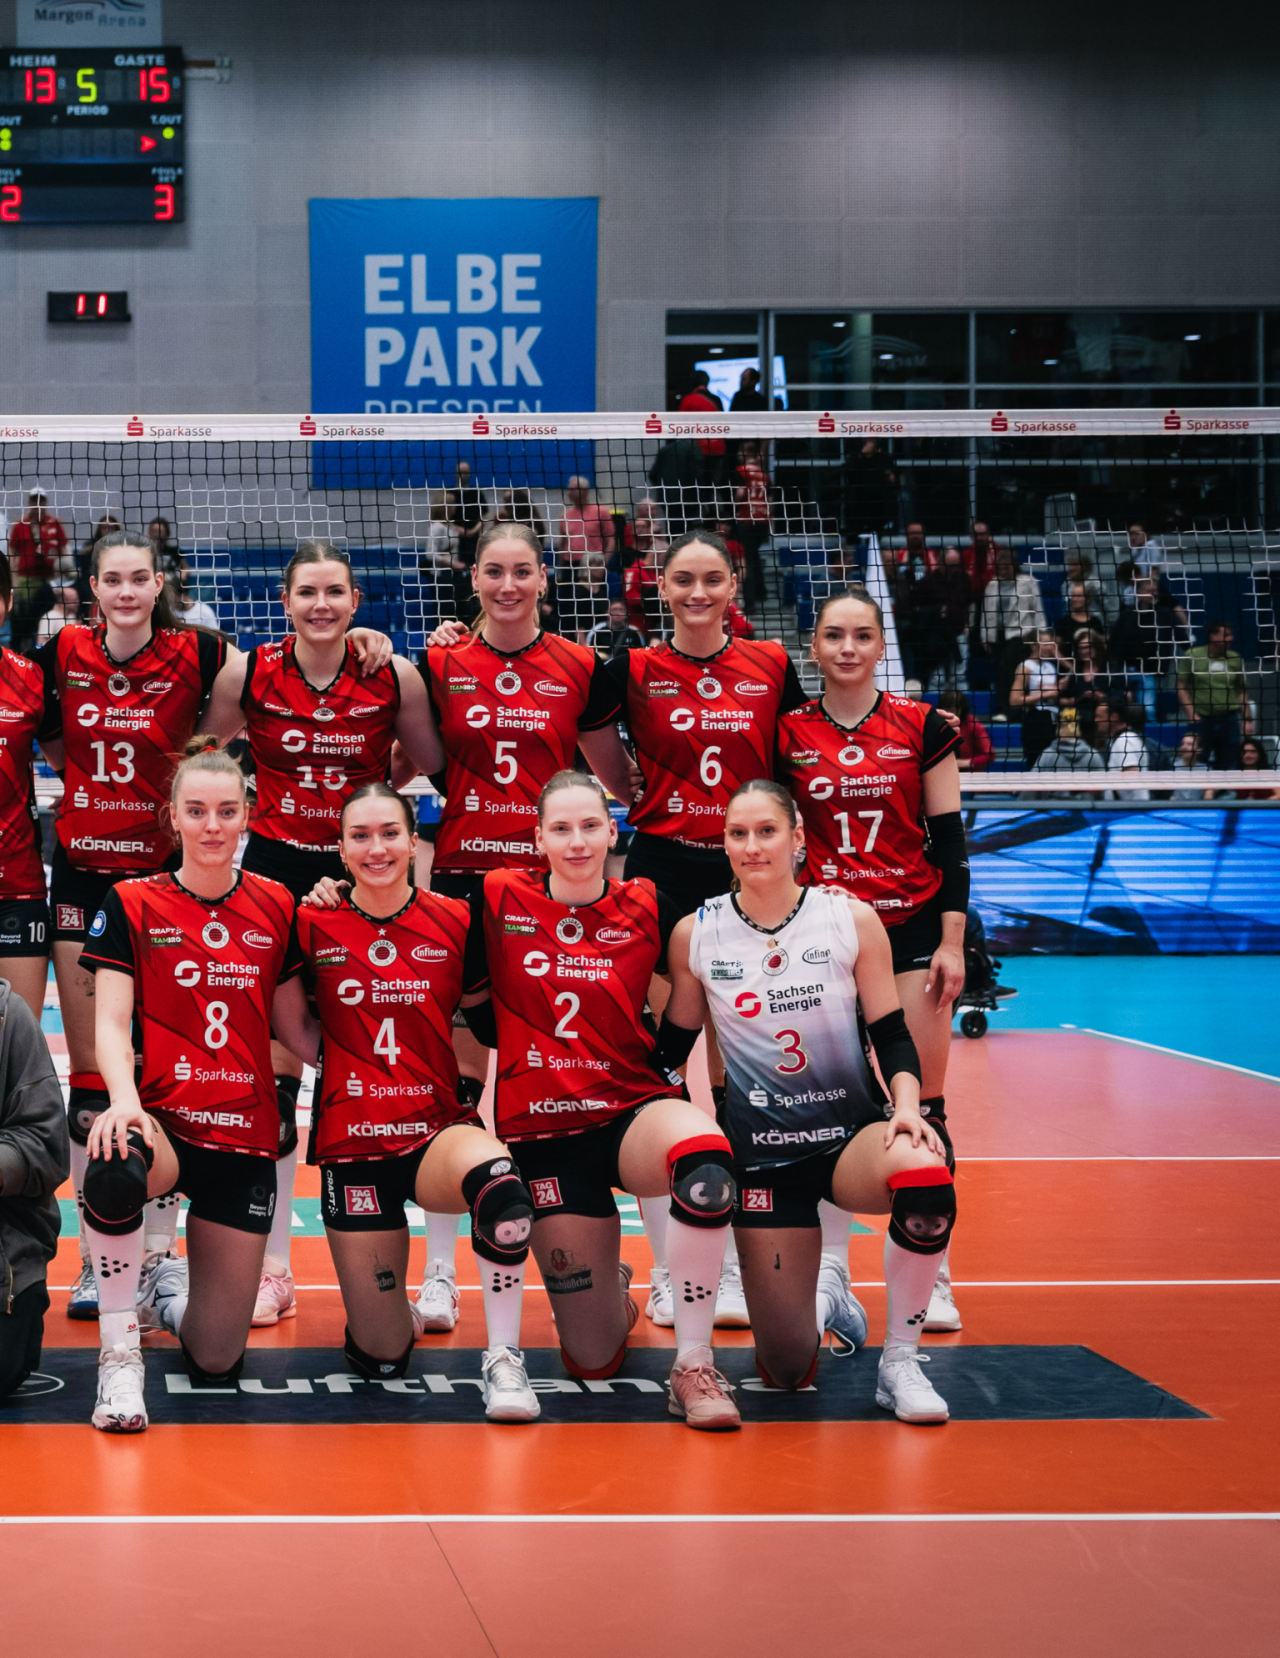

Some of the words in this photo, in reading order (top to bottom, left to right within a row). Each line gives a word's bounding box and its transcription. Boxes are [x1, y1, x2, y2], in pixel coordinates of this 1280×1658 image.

[35, 9, 94, 23] Margon
[98, 14, 147, 27] Arena
[10, 55, 57, 67] HEIM
[24, 68, 56, 103] 13
[76, 68, 98, 103] 5
[139, 67, 171, 102] 15
[66, 105, 109, 116] PERIOD
[150, 114, 182, 125] T.OUT
[0, 185, 21, 221] 2
[154, 184, 174, 220] 3
[364, 253, 542, 314] ELBE
[365, 326, 543, 387] PARK
[149, 425, 212, 439] Sparkasse
[322, 425, 385, 438] Sparkasse
[495, 424, 557, 437] Sparkasse
[667, 422, 730, 436] Sparkasse
[840, 421, 903, 435] Sparkasse
[1014, 420, 1076, 434] Sparkasse
[1186, 418, 1249, 432] Sparkasse
[67, 670, 89, 679] CRAFT
[105, 706, 154, 718] Sachsen
[497, 706, 550, 719] Sachsen
[701, 709, 754, 719] Sachsen
[104, 717, 150, 731] Energie
[496, 718, 546, 732] Energie
[701, 720, 750, 732] Energie
[312, 732, 366, 744] Sachsen
[312, 745, 363, 757] Energie
[90, 741, 135, 783] 13
[493, 741, 518, 784] 5
[700, 745, 722, 787] 6
[296, 765, 348, 790] 15
[840, 774, 897, 786] Sachsen
[840, 786, 893, 798] Energie
[93, 797, 155, 812] Sparkasse
[485, 801, 538, 815] Sparkass
[833, 810, 883, 854] 17
[842, 866, 906, 881] Sparkasse
[60, 915, 80, 927] 24
[505, 915, 531, 923] CRAFT
[28, 921, 46, 943] 10
[149, 927, 176, 935] CRAFT
[505, 924, 536, 933] TEAMBRO
[316, 947, 341, 956] CRAFT
[207, 961, 260, 975] Sachsen
[557, 954, 613, 968] Sachsen
[557, 966, 609, 981] Energie
[207, 975, 255, 990] Energie
[371, 979, 430, 991] Sachsen
[372, 992, 426, 1005] Energie
[766, 983, 824, 1001] Sachsen
[769, 995, 822, 1014] Energie
[554, 991, 580, 1039] 2
[204, 1000, 229, 1050] 8
[373, 1018, 401, 1065] 4
[773, 1029, 807, 1074] 3
[548, 1055, 611, 1071] Sparkasse
[194, 1068, 255, 1083] Sparkasse
[369, 1083, 433, 1099] Sparkasse
[774, 1087, 847, 1109] Sparkasse
[326, 1169, 336, 1206] CRAFT
[534, 1181, 553, 1190] TAG
[350, 1189, 371, 1197] TAG
[536, 1190, 557, 1205] 24
[351, 1197, 374, 1211] 24
[747, 1194, 768, 1208] 24
